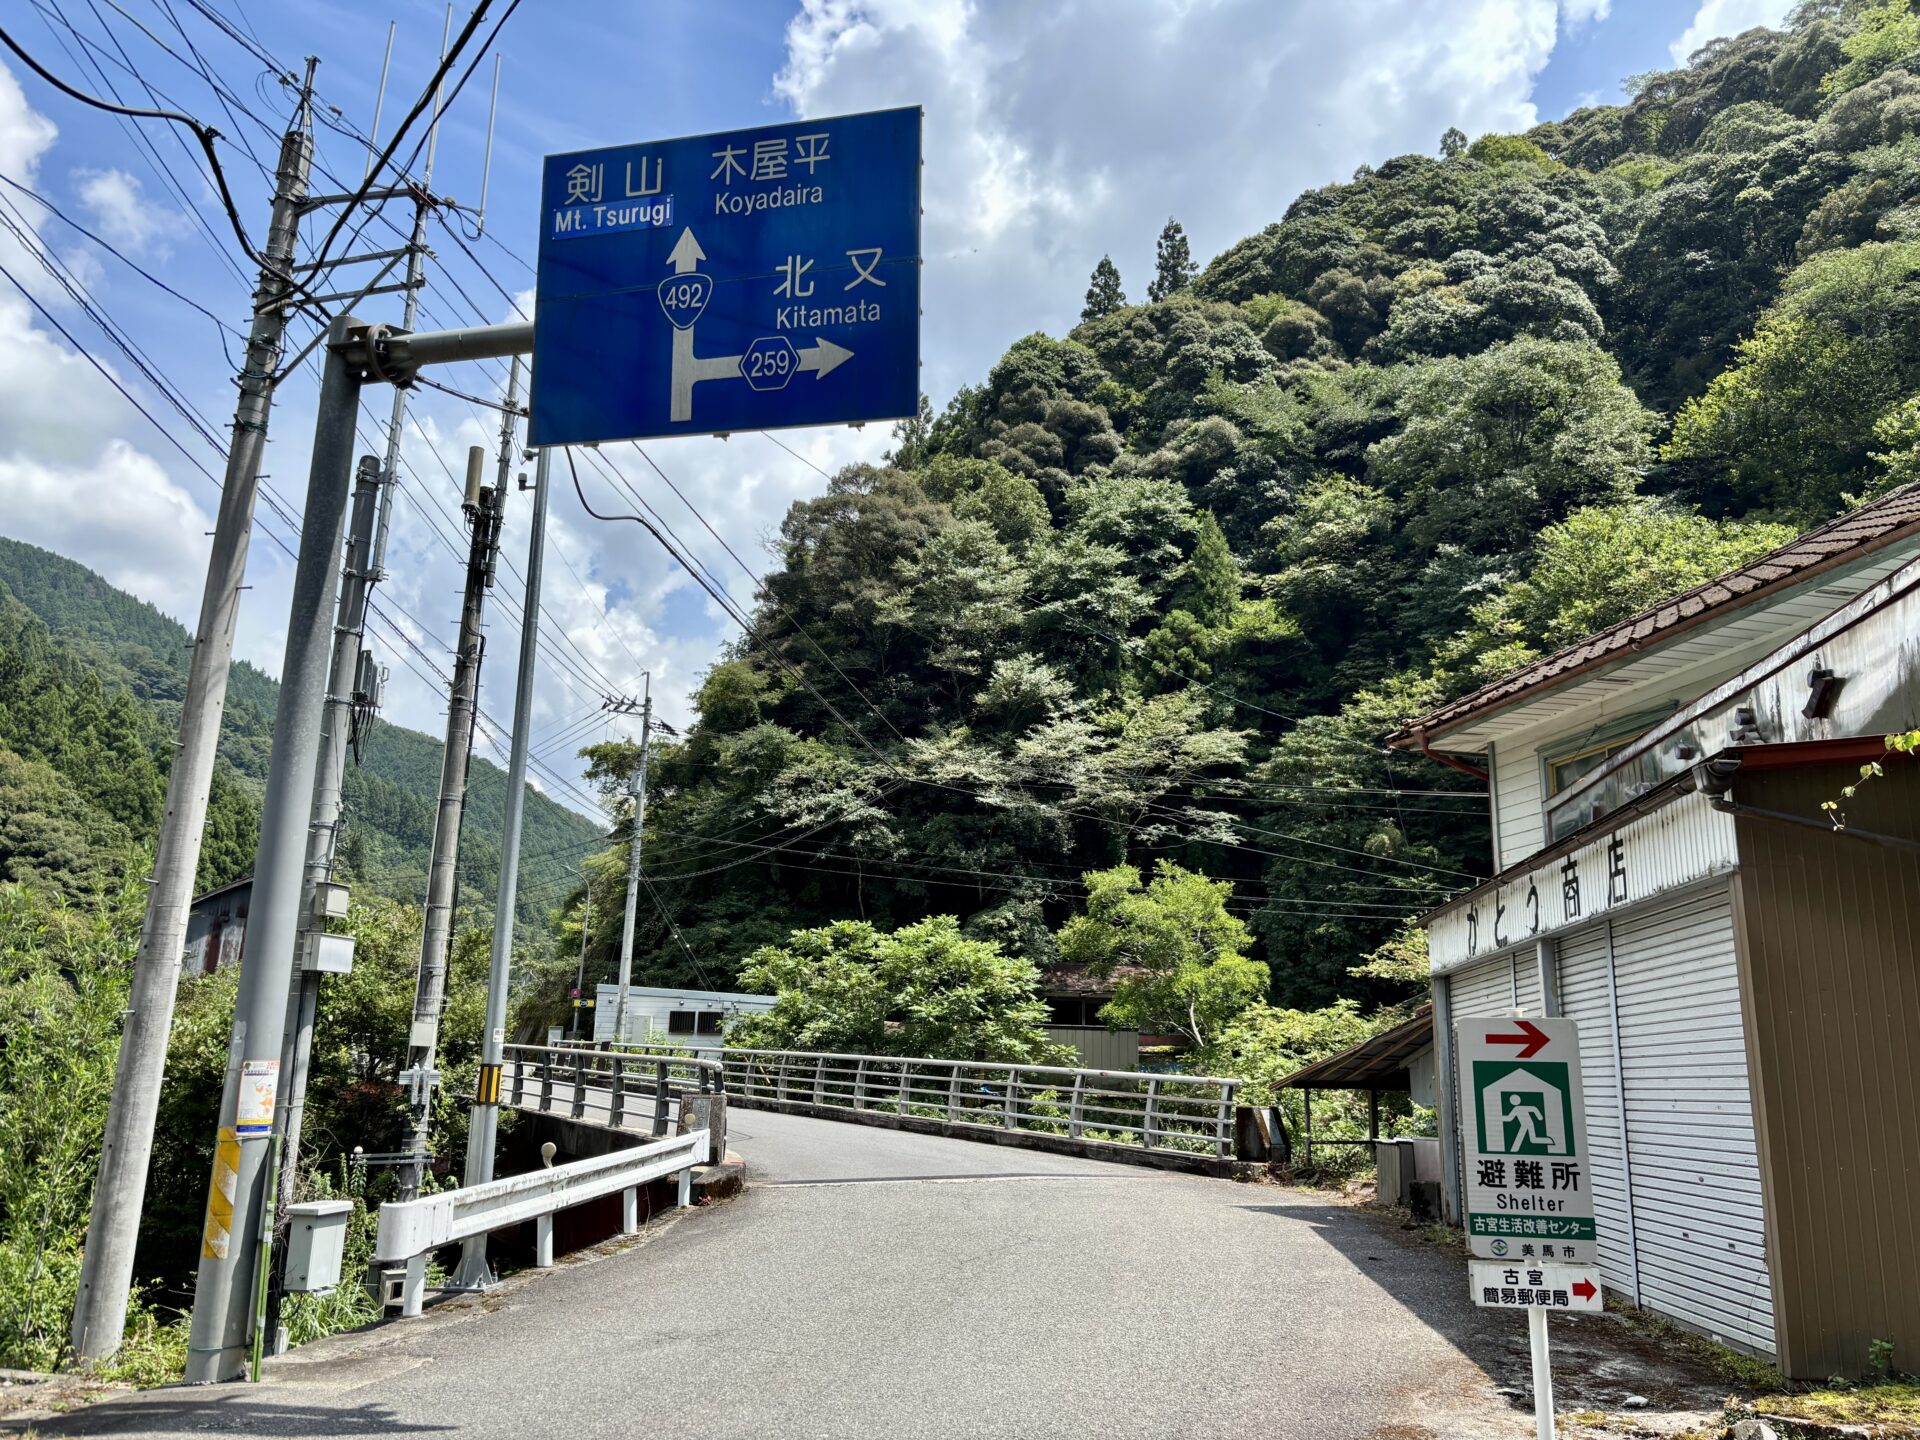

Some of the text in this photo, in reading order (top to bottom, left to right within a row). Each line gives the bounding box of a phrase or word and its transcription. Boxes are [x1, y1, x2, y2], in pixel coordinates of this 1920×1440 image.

[710, 133, 831, 185] 木屋平
[564, 156, 663, 205] 剣山
[714, 184, 823, 216] Koyadaira
[555, 198, 671, 233] Mt. Tsurugi
[773, 248, 886, 299] 北又
[665, 283, 703, 310] 492
[776, 300, 881, 330] Kitamata
[750, 350, 790, 378] 259
[1466, 832, 1628, 959] かとう商店
[1477, 1159, 1581, 1192] 避難所
[1496, 1193, 1565, 1212] Shelter
[1474, 1217, 1591, 1234] 古宮生活改善センター
[1522, 1244, 1575, 1258] 美馬市
[1503, 1268, 1543, 1286] 古宮
[1483, 1287, 1569, 1307] 簡易郵便局
